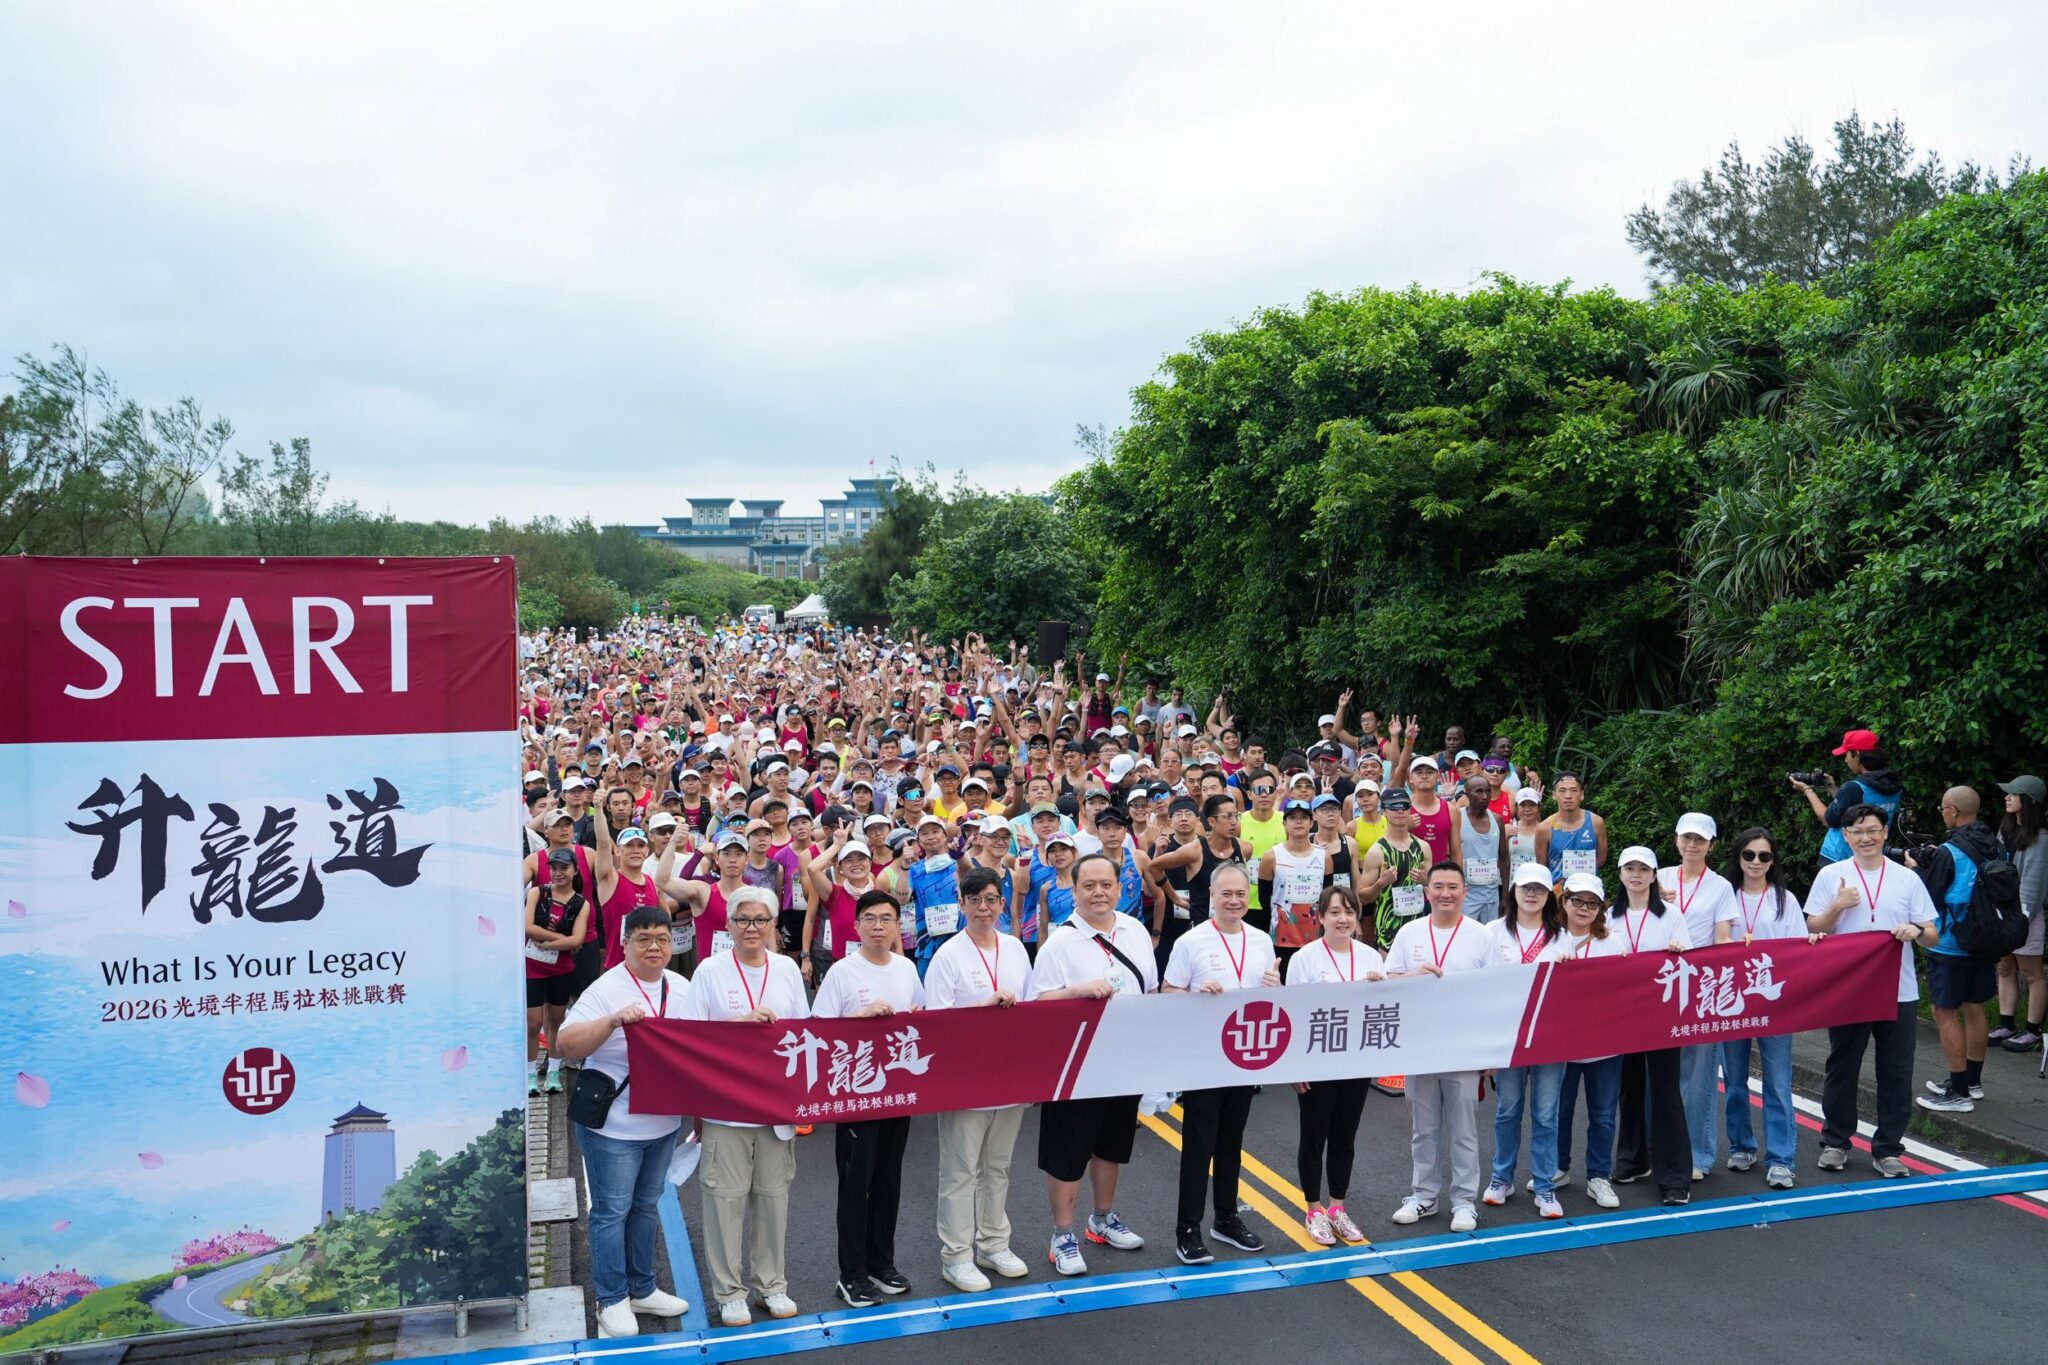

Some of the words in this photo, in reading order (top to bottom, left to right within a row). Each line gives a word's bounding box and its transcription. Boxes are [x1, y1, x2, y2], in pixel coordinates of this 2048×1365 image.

[59, 595, 434, 700] START
[64, 772, 436, 925] 升龍道
[101, 957, 182, 986] What
[194, 956, 217, 981] Is
[226, 953, 297, 979] Your
[308, 950, 407, 979] Legacy
[1654, 952, 1788, 1018] 升龍道
[101, 984, 408, 1022] 2026光境半程馬拉松挑戰賽
[1306, 1002, 1400, 1054] 龍巖
[773, 1025, 936, 1096] 升龍道
